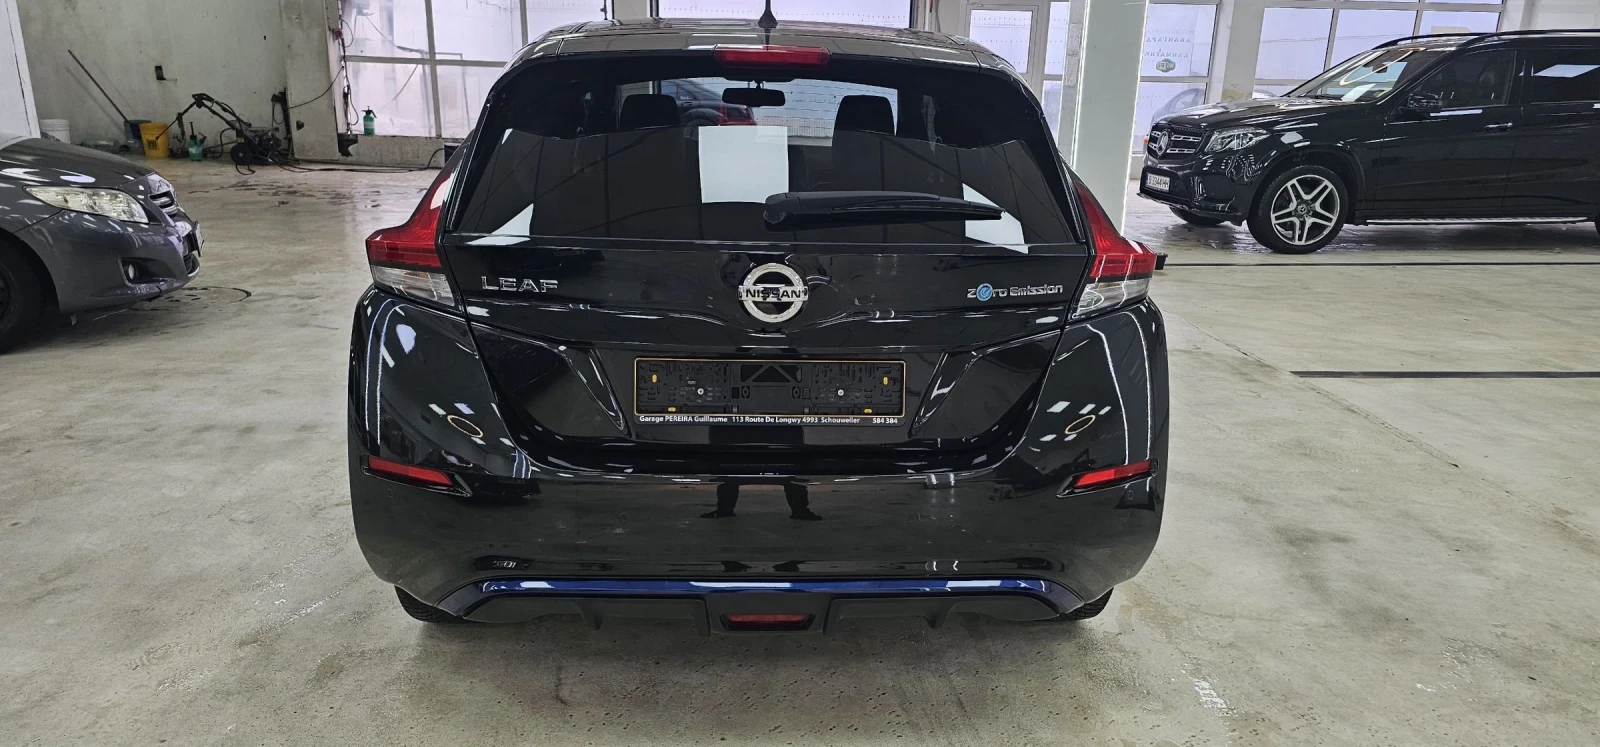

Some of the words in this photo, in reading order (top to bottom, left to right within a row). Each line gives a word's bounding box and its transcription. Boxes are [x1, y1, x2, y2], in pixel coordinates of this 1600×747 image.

[481, 276, 559, 293] LEAF
[1009, 284, 1063, 296] Emission
[746, 289, 801, 299] NISSAN
[639, 415, 663, 423] Garage
[775, 416, 801, 424] Longwy
[820, 416, 860, 424] Schouweiler
